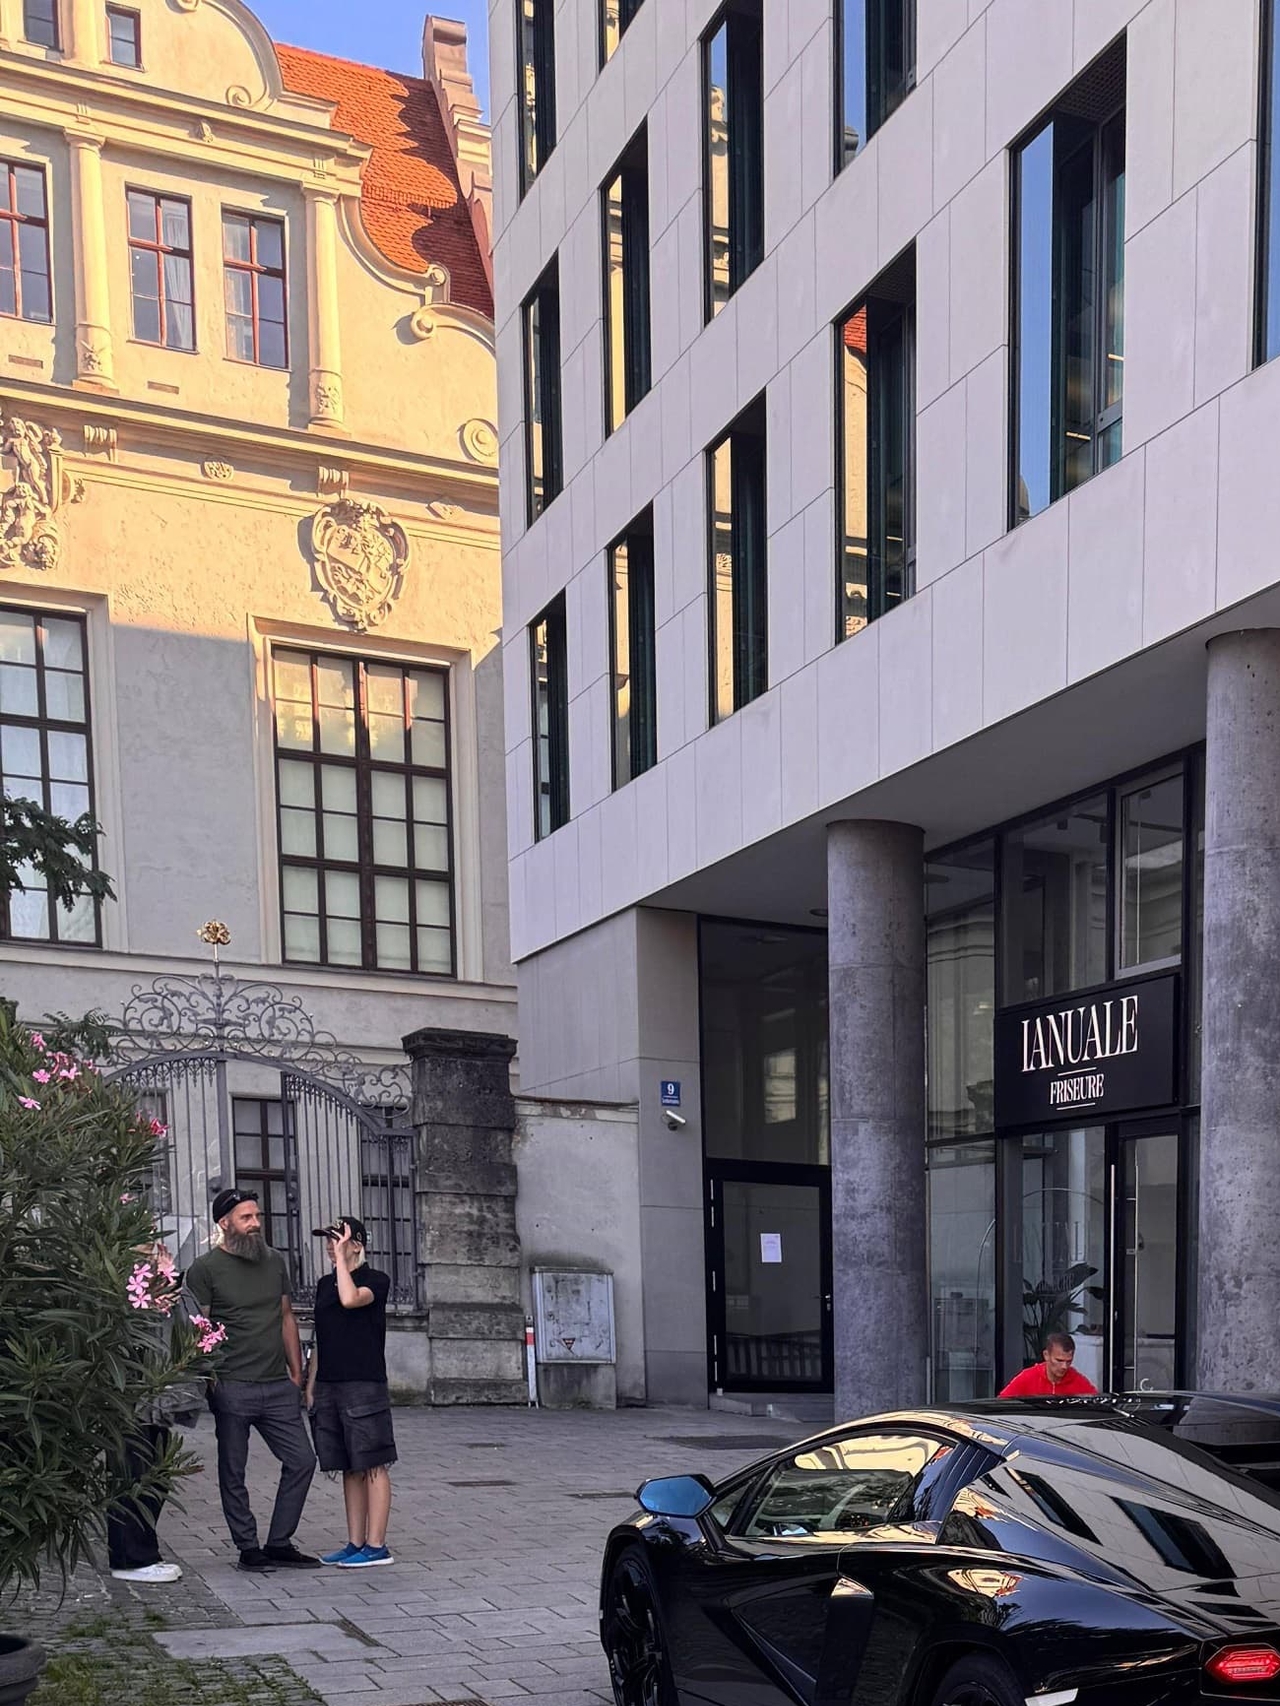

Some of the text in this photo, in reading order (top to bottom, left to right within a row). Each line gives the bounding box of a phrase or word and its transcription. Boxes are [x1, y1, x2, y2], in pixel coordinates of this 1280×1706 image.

[1021, 995, 1138, 1072] IANUALE
[667, 1083, 675, 1095] 9
[1050, 1073, 1104, 1104] FRISEURE
